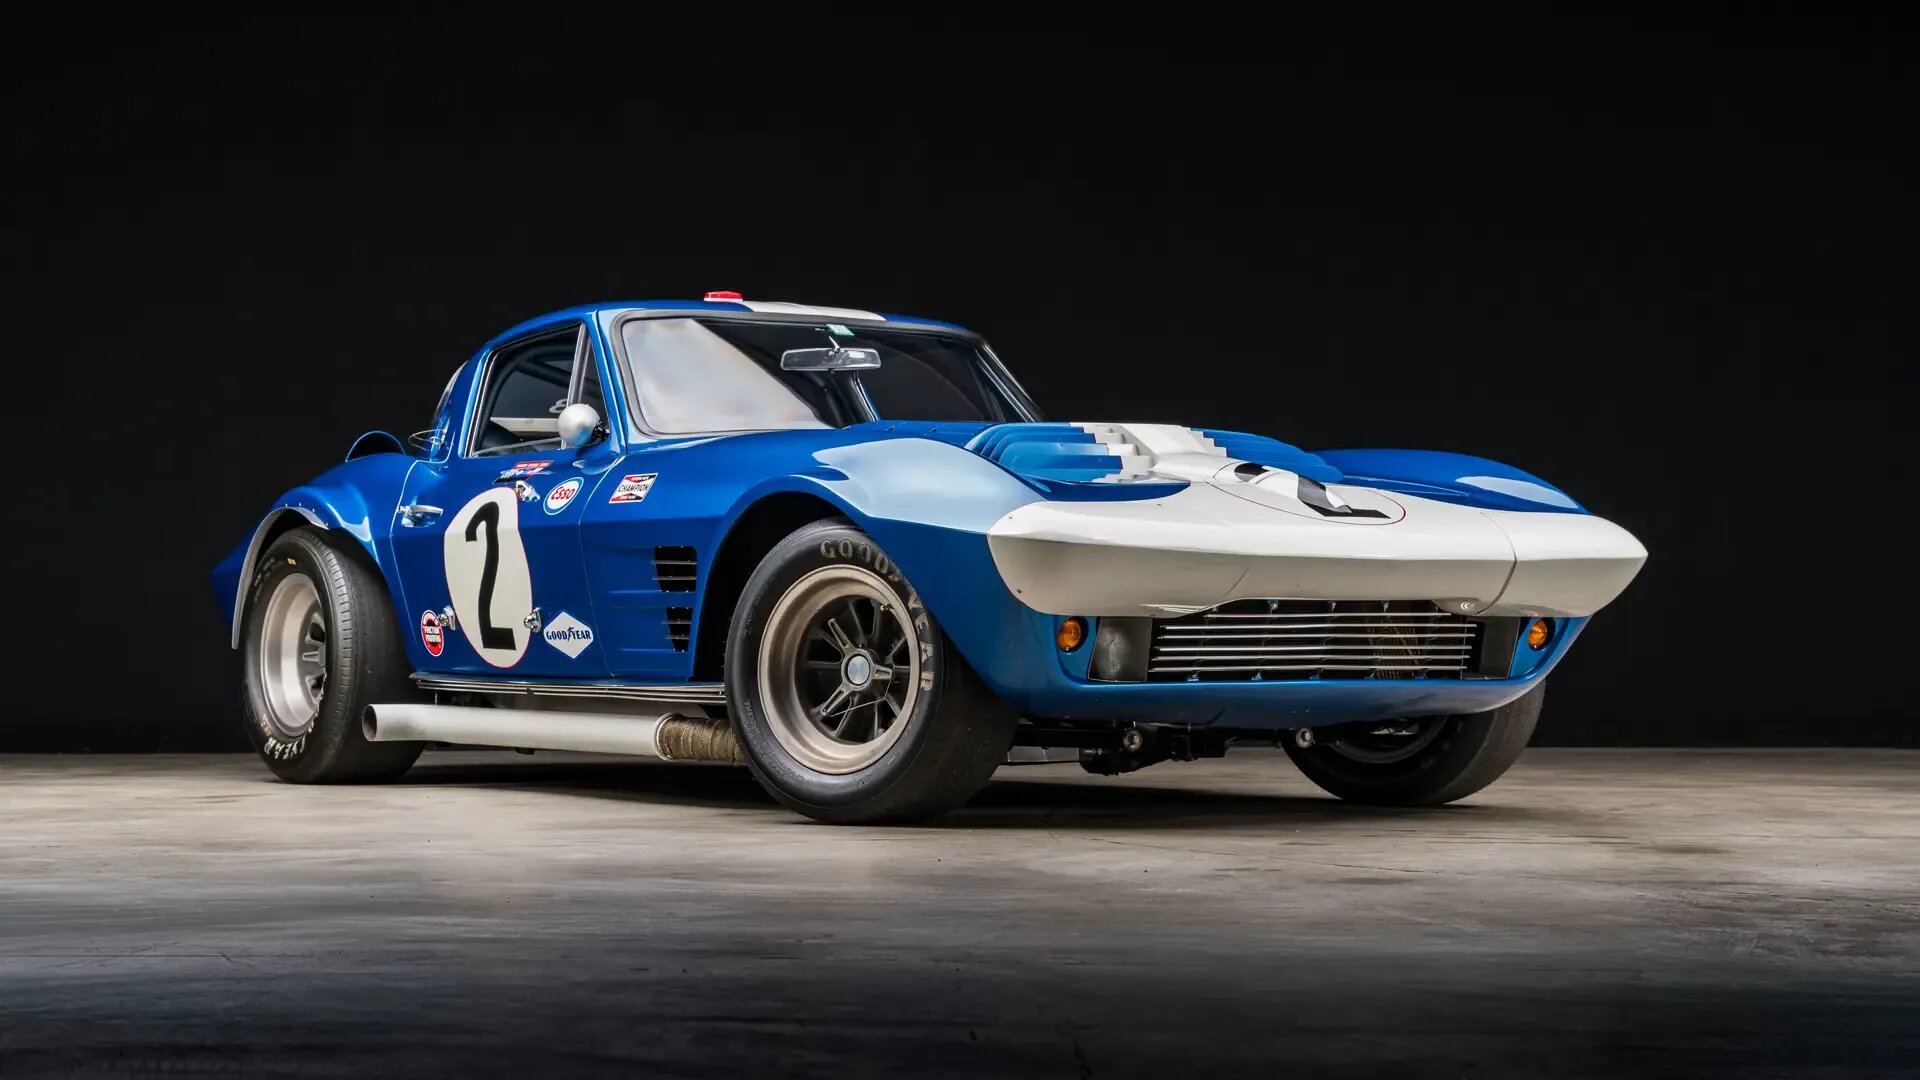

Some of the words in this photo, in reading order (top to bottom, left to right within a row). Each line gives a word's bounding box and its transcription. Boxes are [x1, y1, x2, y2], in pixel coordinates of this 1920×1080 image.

[618, 483, 650, 493] CHAMPION
[465, 501, 517, 651] 2
[546, 627, 592, 642] GOODYEAR
